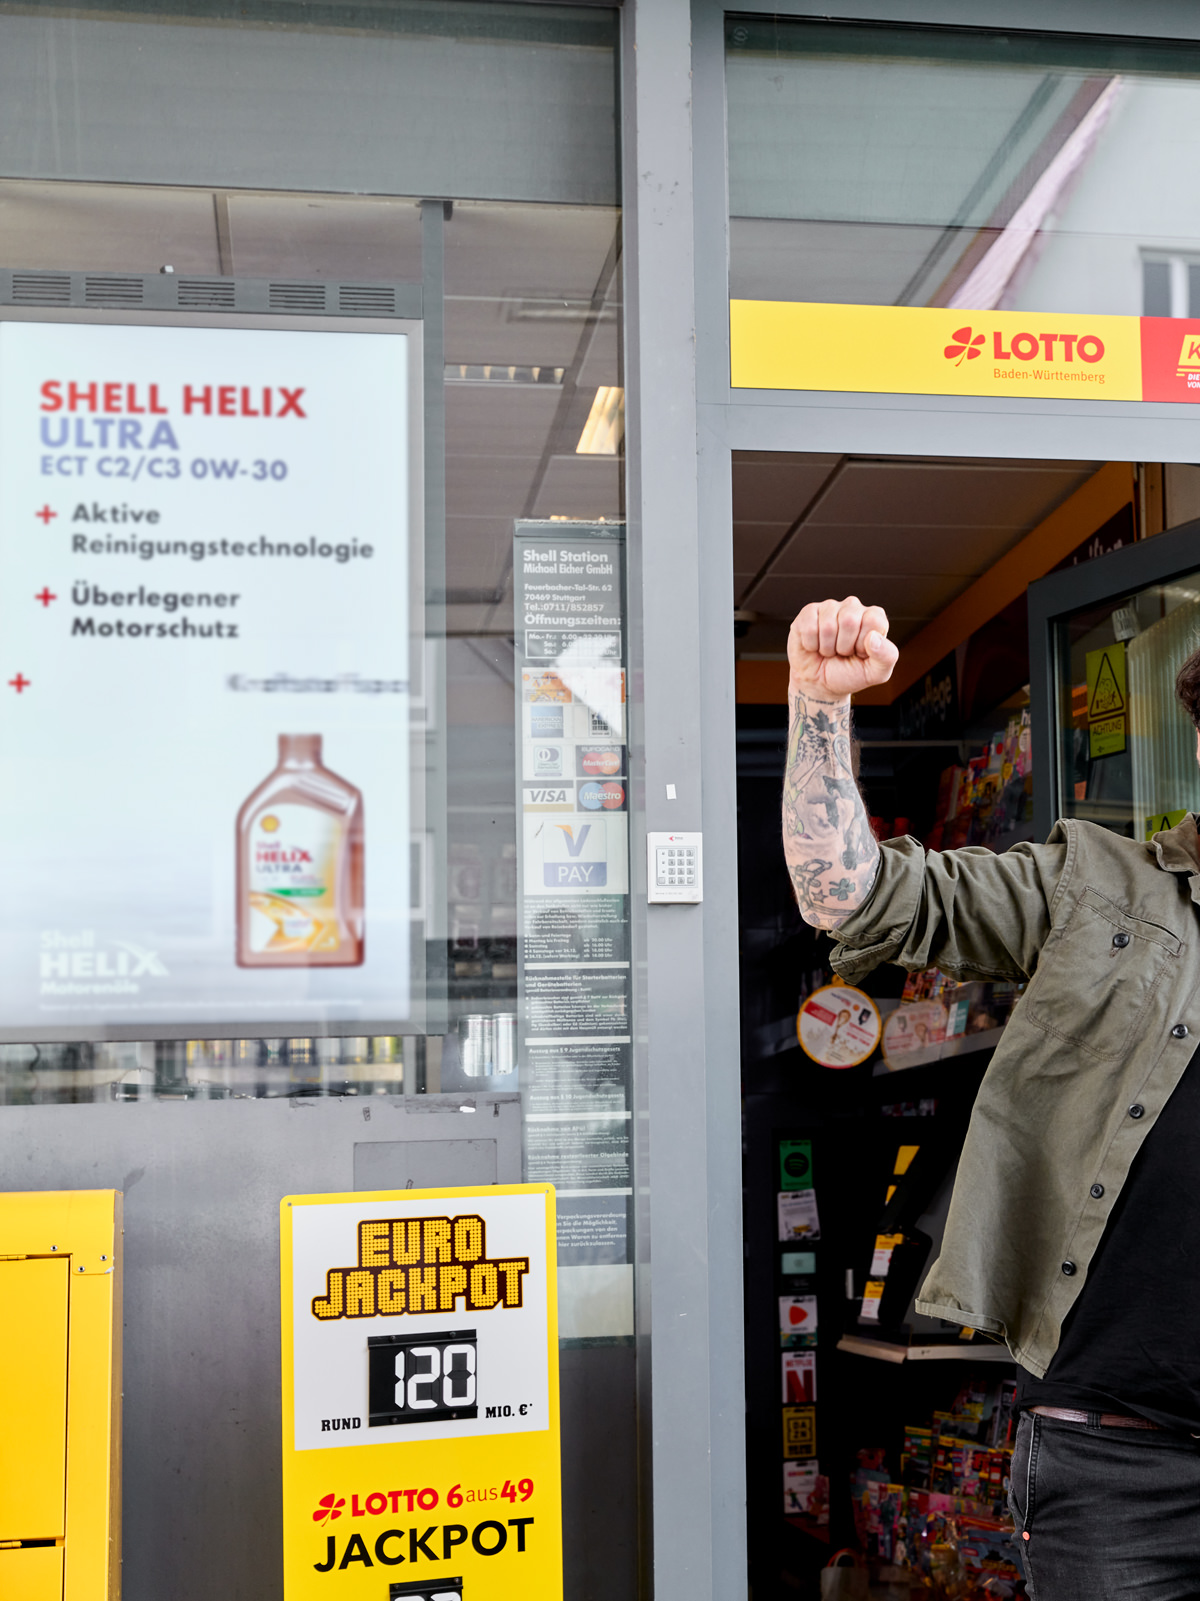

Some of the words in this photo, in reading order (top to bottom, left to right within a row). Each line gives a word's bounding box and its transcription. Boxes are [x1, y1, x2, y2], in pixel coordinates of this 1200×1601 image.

[993, 331, 1105, 363] LOTTO
[993, 368, 1105, 385] Baden-Württemberg
[40, 380, 168, 414] SHELL
[182, 384, 307, 418] HELIX
[40, 417, 179, 450] ULTRA
[41, 455, 88, 476] ECT
[96, 456, 181, 482] C2/C3
[190, 458, 288, 481] 0W-30
[72, 503, 160, 525] Aktive
[71, 534, 374, 563] Reinigungstechnologie
[523, 550, 557, 562] Shell
[560, 551, 608, 562] Station
[524, 563, 557, 574] Michael
[560, 564, 583, 574] Eicher
[586, 564, 613, 575] GmbH
[71, 580, 241, 612] Überlegener
[552, 594, 586, 602] Stuttgart
[71, 617, 239, 639] Motorschutz
[524, 612, 621, 627] Öffnungszeiten:
[1093, 720, 1122, 736] ACHTUNG
[530, 790, 567, 802] VISA
[584, 792, 621, 800] Maestro
[554, 824, 592, 857] V
[256, 850, 313, 863] HELIX
[558, 866, 593, 883] PAY
[40, 929, 96, 949] Shell
[39, 938, 171, 979] HELIX
[40, 979, 140, 996] Motorenöle
[359, 1216, 484, 1267] EURO
[313, 1259, 528, 1320] JACKPOT
[321, 1417, 361, 1432] RUND
[394, 1344, 476, 1410] 120
[485, 1405, 516, 1419] MIO.
[351, 1488, 439, 1517] LOTTO
[313, 1517, 535, 1573] JACKPOT
